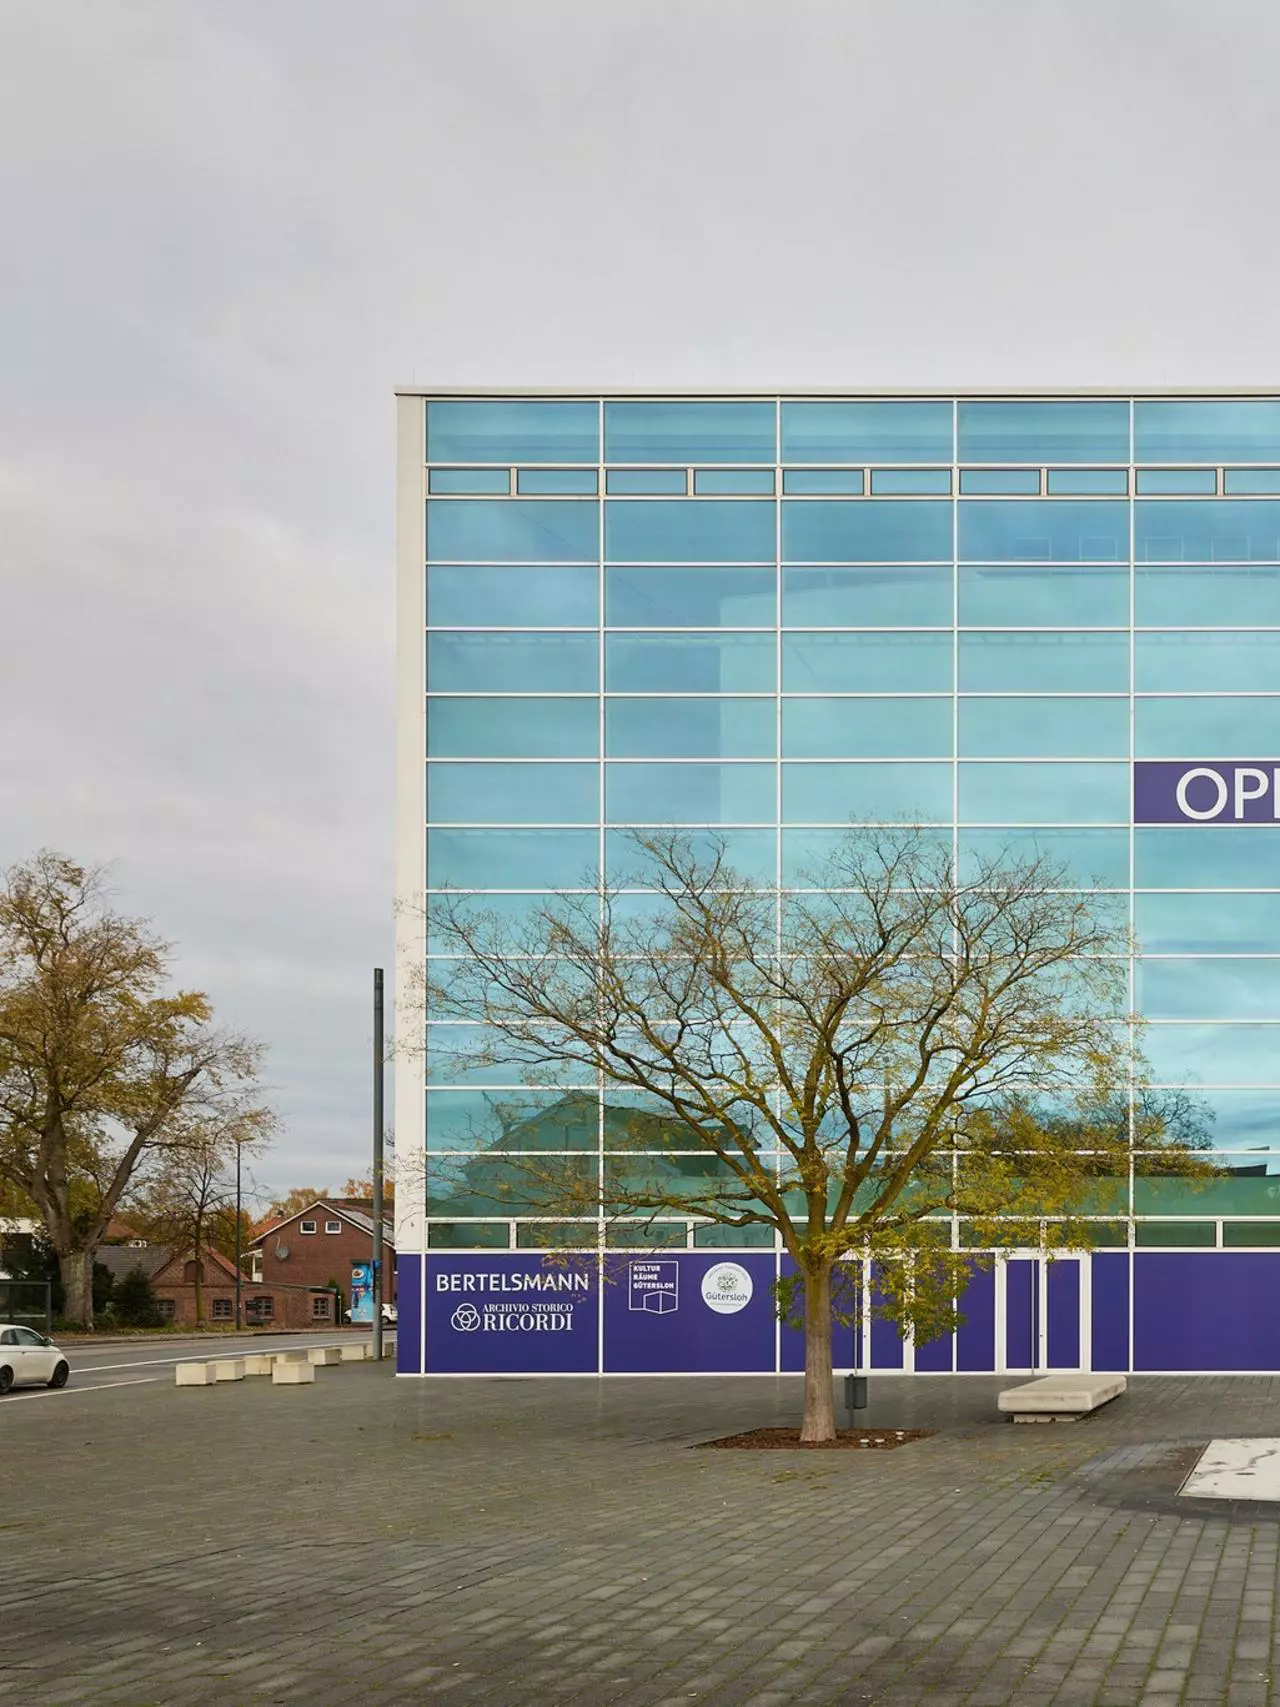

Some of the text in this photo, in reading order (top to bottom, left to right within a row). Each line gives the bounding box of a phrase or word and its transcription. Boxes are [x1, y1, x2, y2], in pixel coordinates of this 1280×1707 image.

[436, 1273, 589, 1292] BERTELSMANN
[633, 1273, 658, 1281] RÄUME
[705, 1291, 748, 1302] Gütersloh
[482, 1303, 574, 1313] ARCHIVIO STORICO
[483, 1313, 573, 1331] RICORDI
